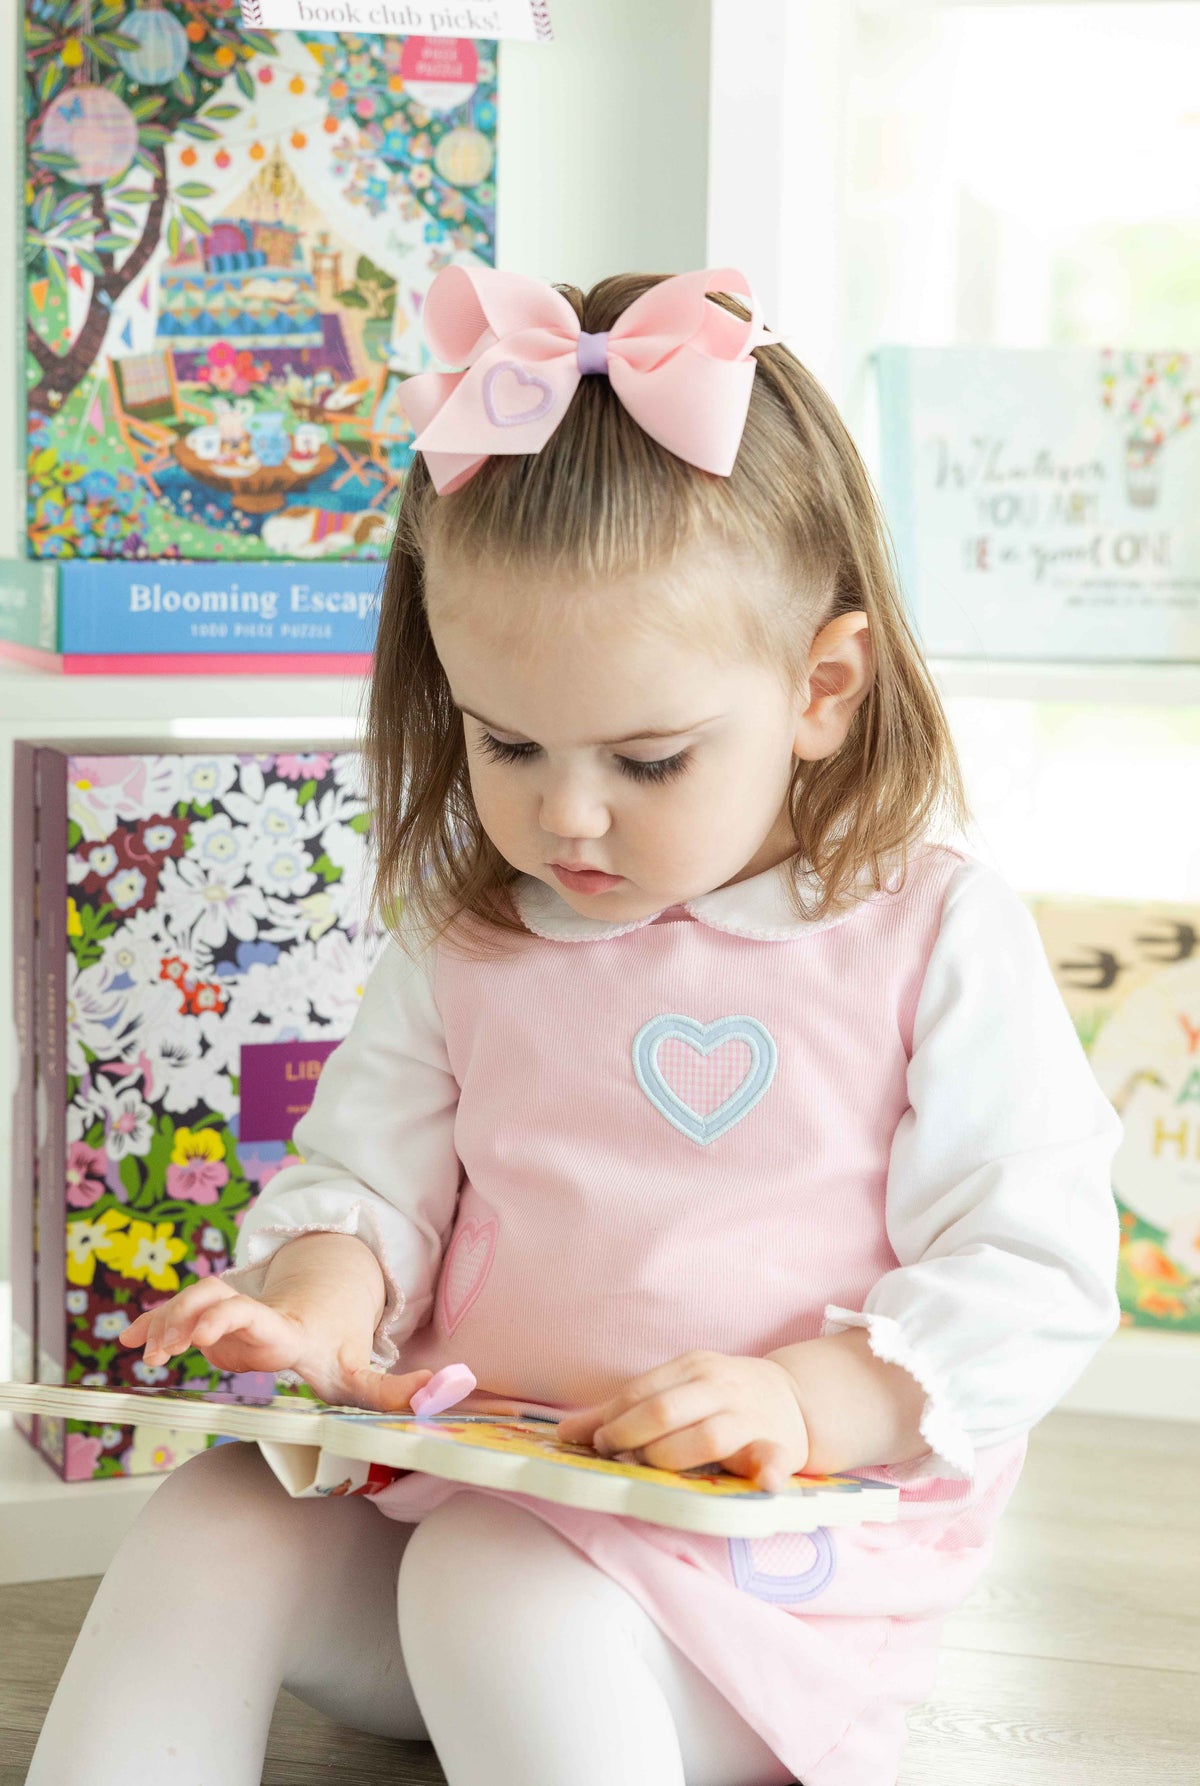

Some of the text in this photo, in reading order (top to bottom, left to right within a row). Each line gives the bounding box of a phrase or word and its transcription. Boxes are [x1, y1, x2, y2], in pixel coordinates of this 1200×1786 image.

[298, 0, 502, 31] book club picks!
[130, 583, 279, 619] Blooming
[191, 623, 332, 639] 1000 PIECE PUZZLE
